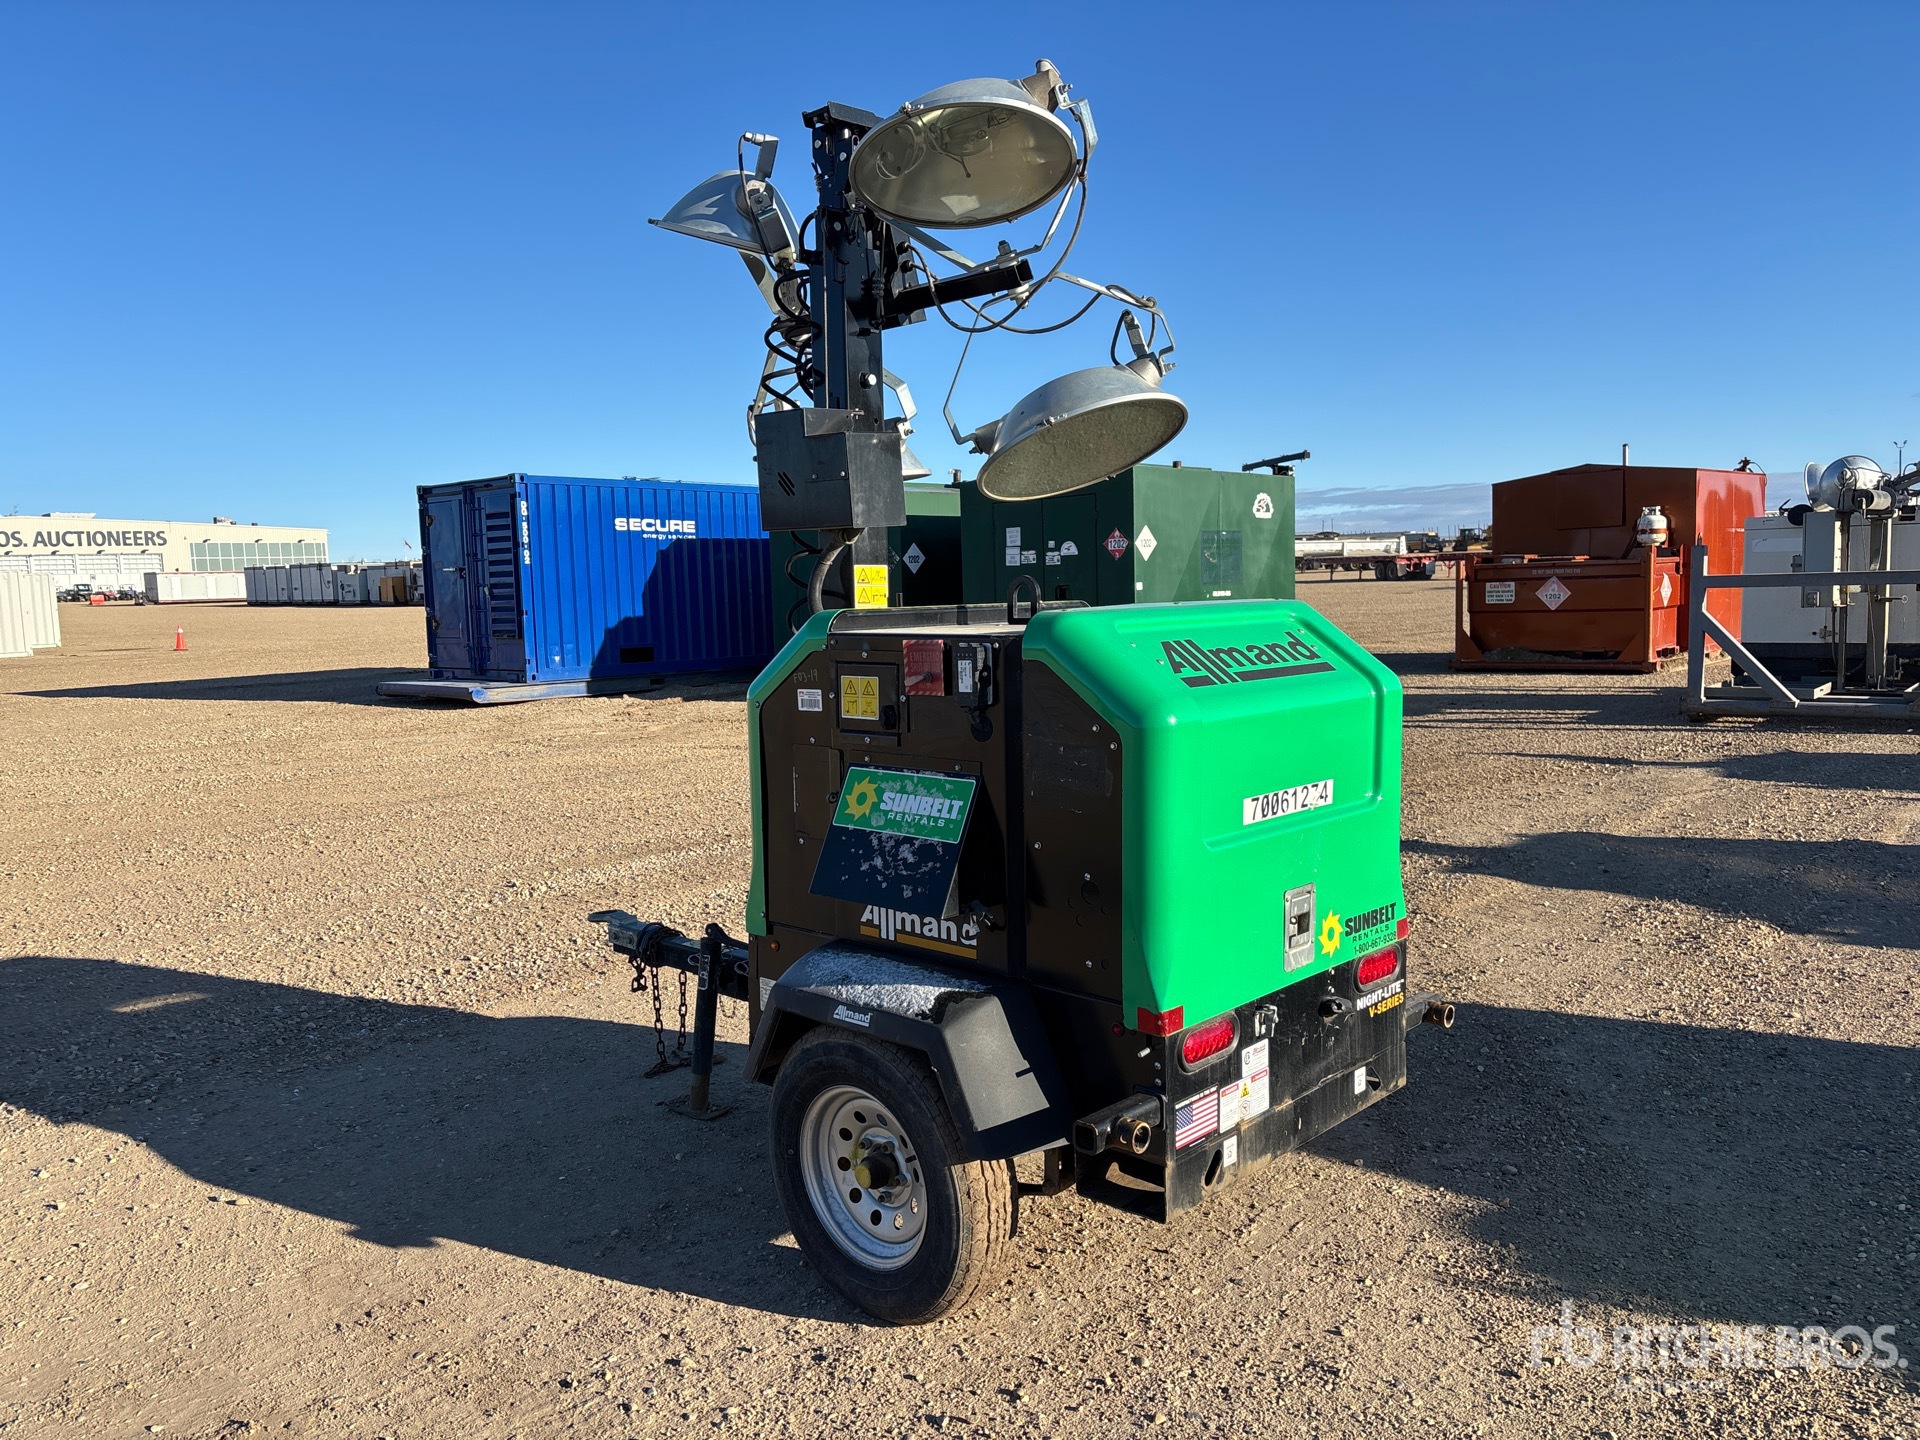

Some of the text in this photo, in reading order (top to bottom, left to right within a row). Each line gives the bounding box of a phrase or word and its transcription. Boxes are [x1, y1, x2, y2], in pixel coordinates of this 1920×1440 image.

[614, 517, 696, 533] SECURE
[32, 530, 168, 547] AUCTIONEERS
[1109, 539, 1126, 549] 1202
[1160, 631, 1323, 685] Allmand
[879, 791, 964, 820] SUNBELT
[1251, 780, 1329, 821] 70061274
[887, 812, 946, 827] RENTALS
[860, 904, 978, 946] Allmand
[1345, 901, 1397, 938] SUNBELT
[1352, 923, 1390, 944] RENTALS
[1353, 930, 1397, 956] 1-800-667-9328
[1356, 980, 1402, 1012] NIGHT-LITE
[1368, 991, 1405, 1018] V-SERIES
[833, 1004, 871, 1024] Allmand
